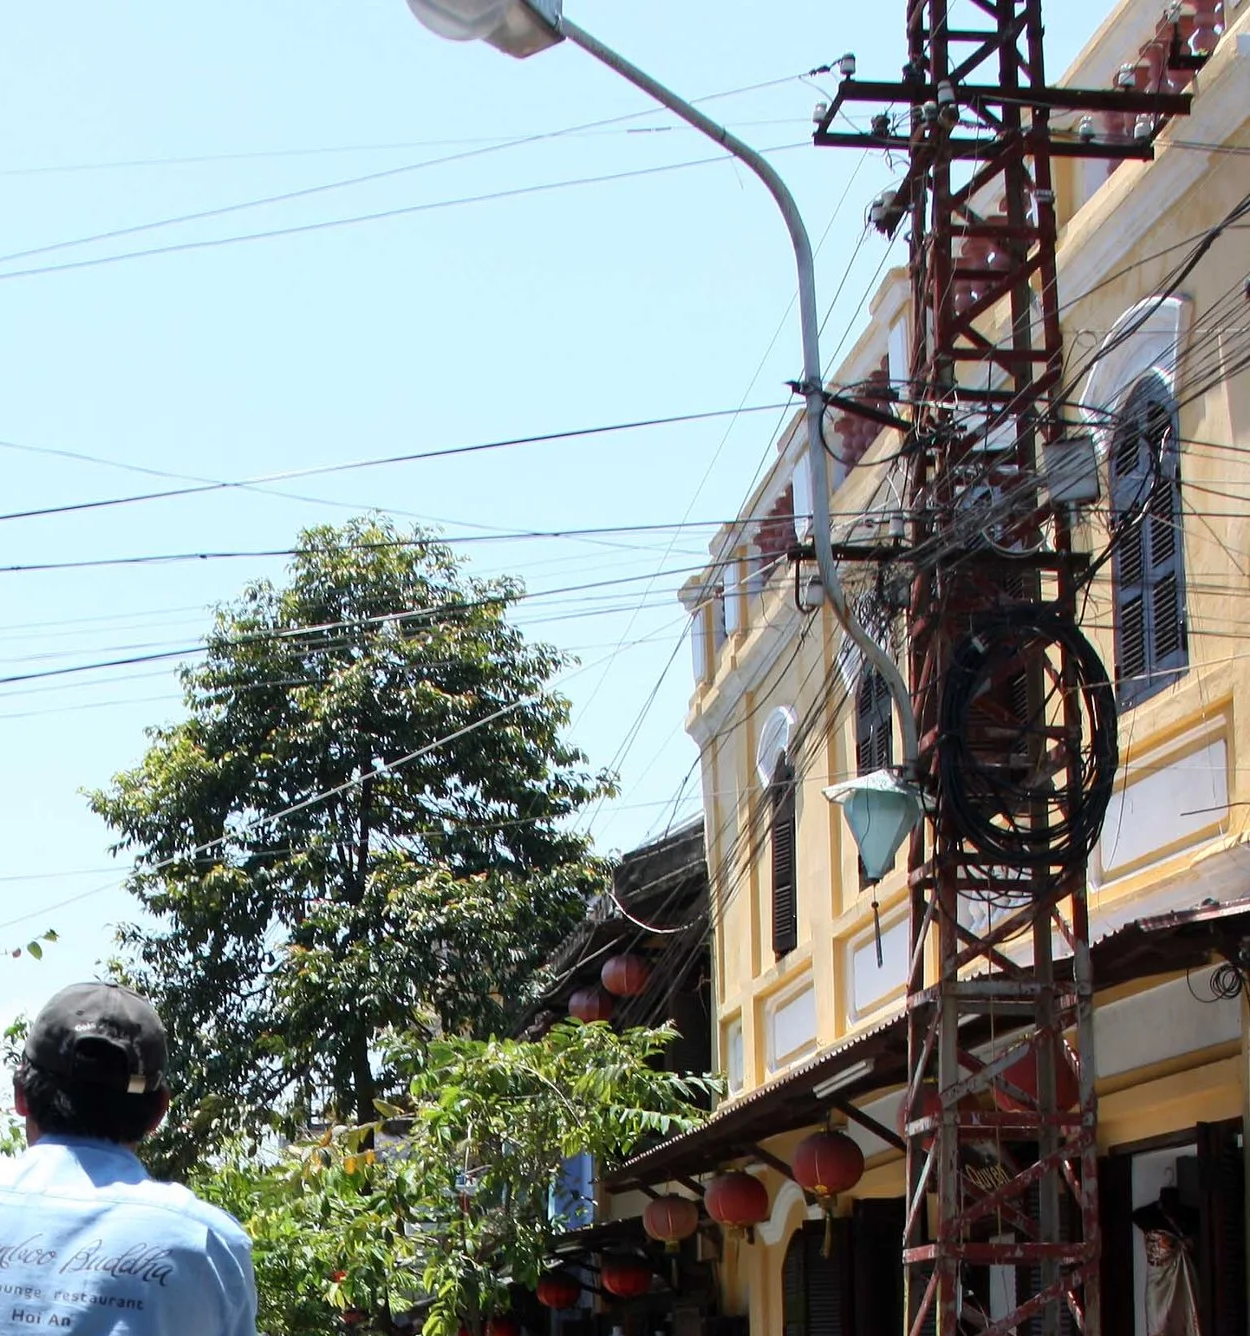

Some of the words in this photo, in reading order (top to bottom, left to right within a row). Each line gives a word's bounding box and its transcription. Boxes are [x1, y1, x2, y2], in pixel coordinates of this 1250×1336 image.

[58, 1238, 175, 1287] Buddha
[54, 1289, 145, 1311] restaurant
[11, 1309, 41, 1325] Hoi
[48, 1312, 71, 1327] An
